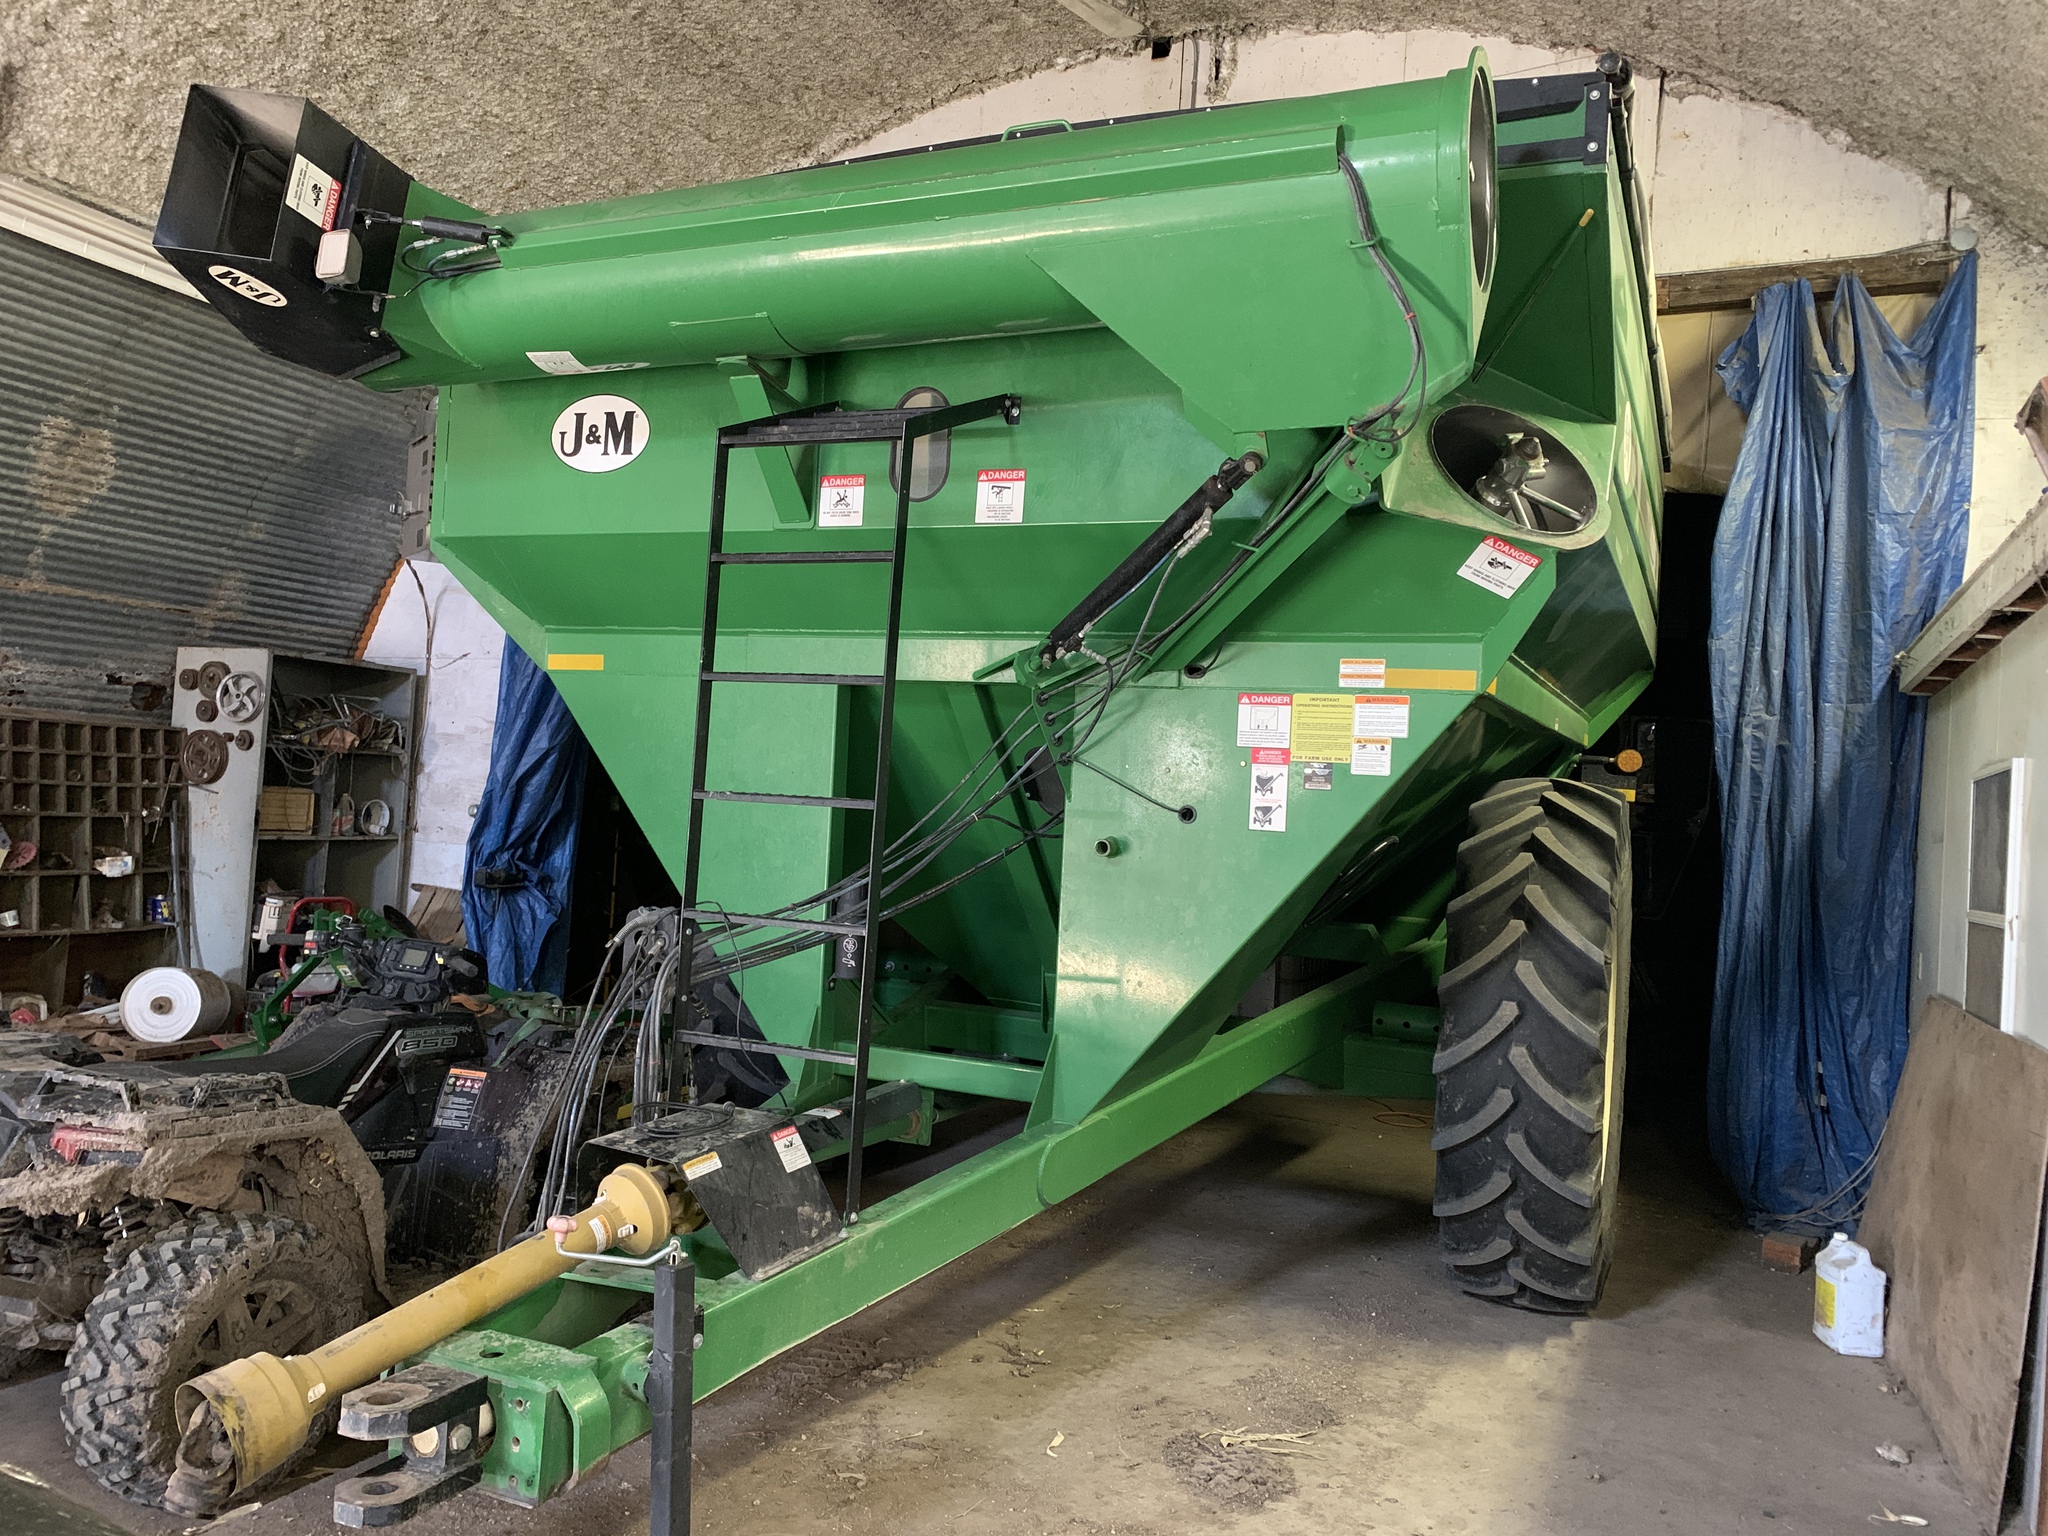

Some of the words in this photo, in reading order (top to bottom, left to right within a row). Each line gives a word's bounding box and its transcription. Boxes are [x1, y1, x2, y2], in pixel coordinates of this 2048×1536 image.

[323, 190, 338, 231] DANGER
[214, 270, 282, 303] J&M
[559, 411, 637, 457] J&M
[829, 477, 865, 486] DANGER
[988, 471, 1025, 480] DANGER
[1494, 542, 1538, 566] DANGER
[1251, 695, 1290, 704] DANGER
[405, 1026, 473, 1038] SPORTSMAN
[400, 1036, 458, 1053] 850
[777, 1128, 797, 1138] DANGER
